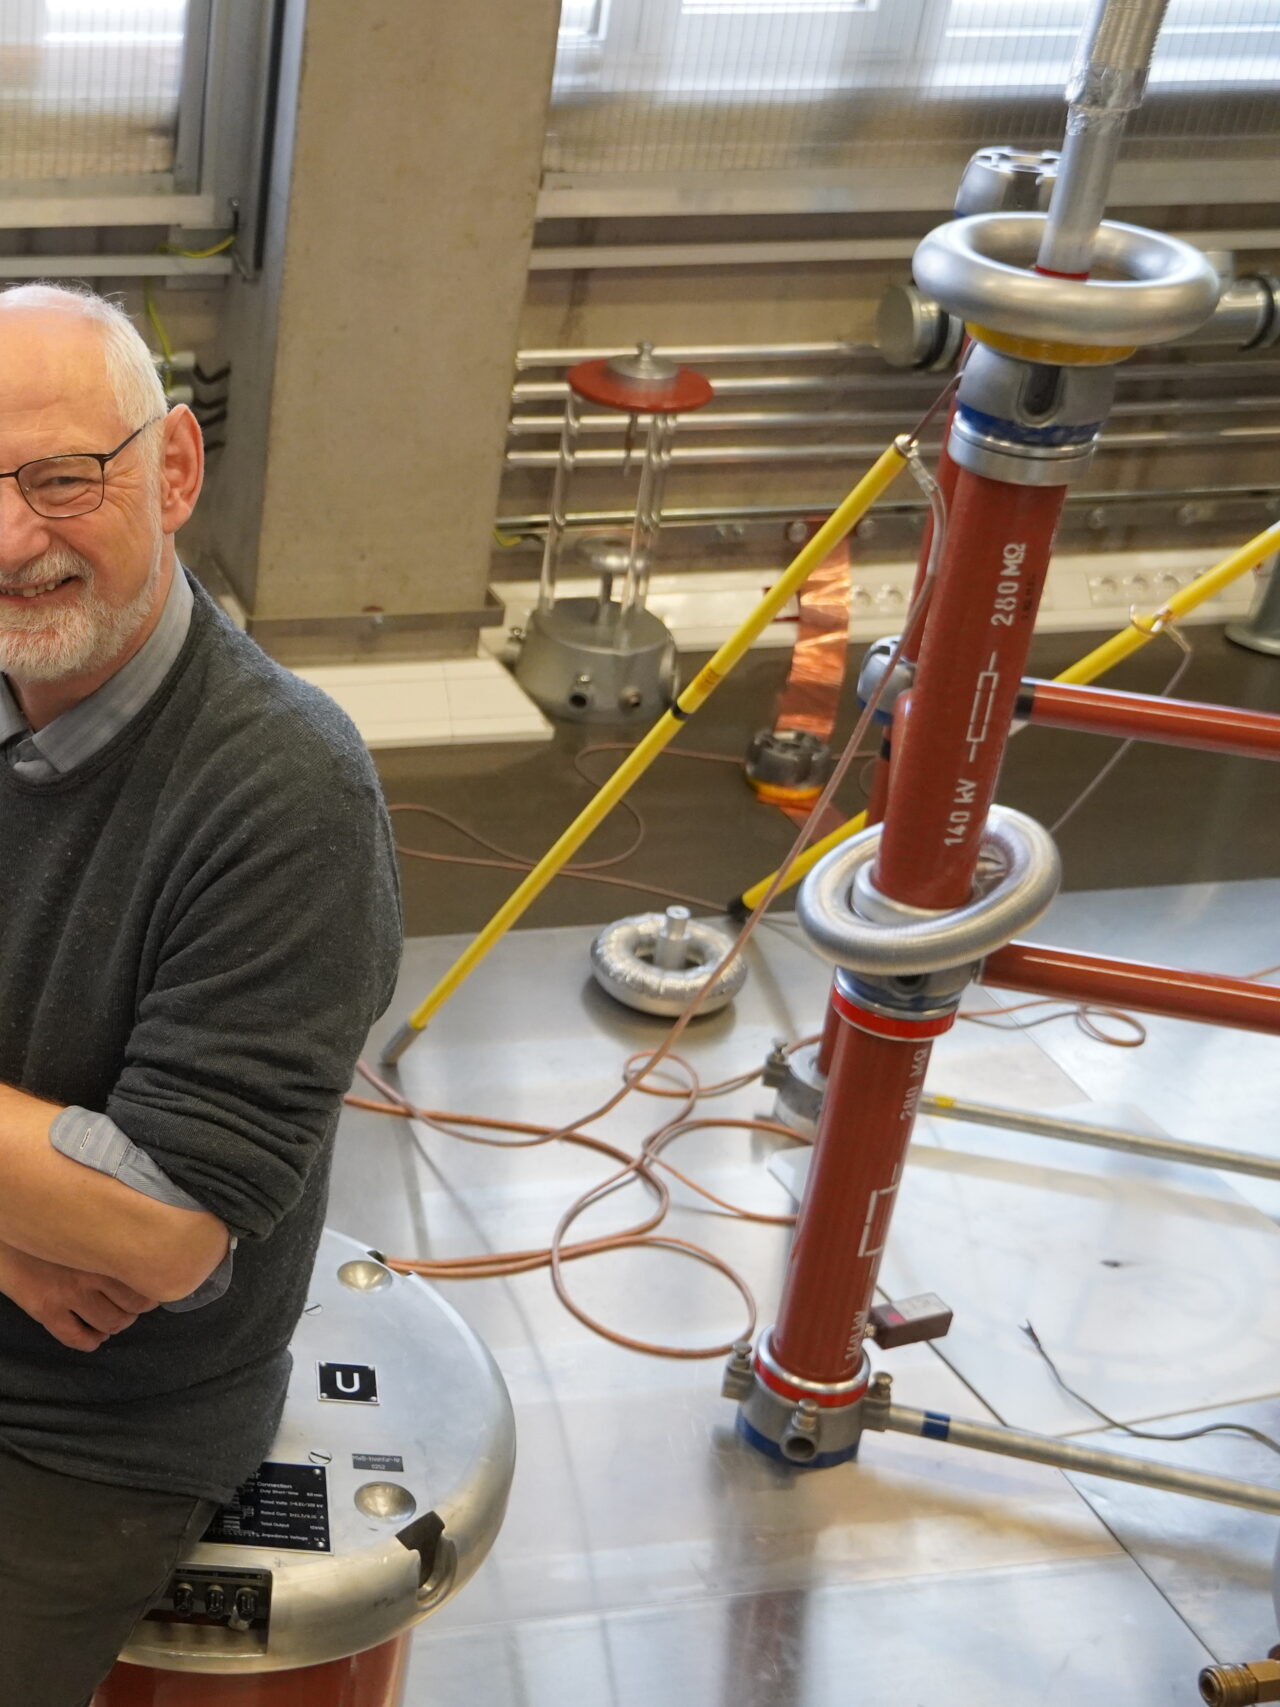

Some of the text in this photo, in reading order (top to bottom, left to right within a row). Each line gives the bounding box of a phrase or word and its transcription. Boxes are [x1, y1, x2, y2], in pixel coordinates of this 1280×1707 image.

[990, 543, 1027, 626] 280 MΩ
[943, 778, 977, 847] 140 kV
[335, 1371, 360, 1394] U
[257, 1481, 293, 1489] Connection
